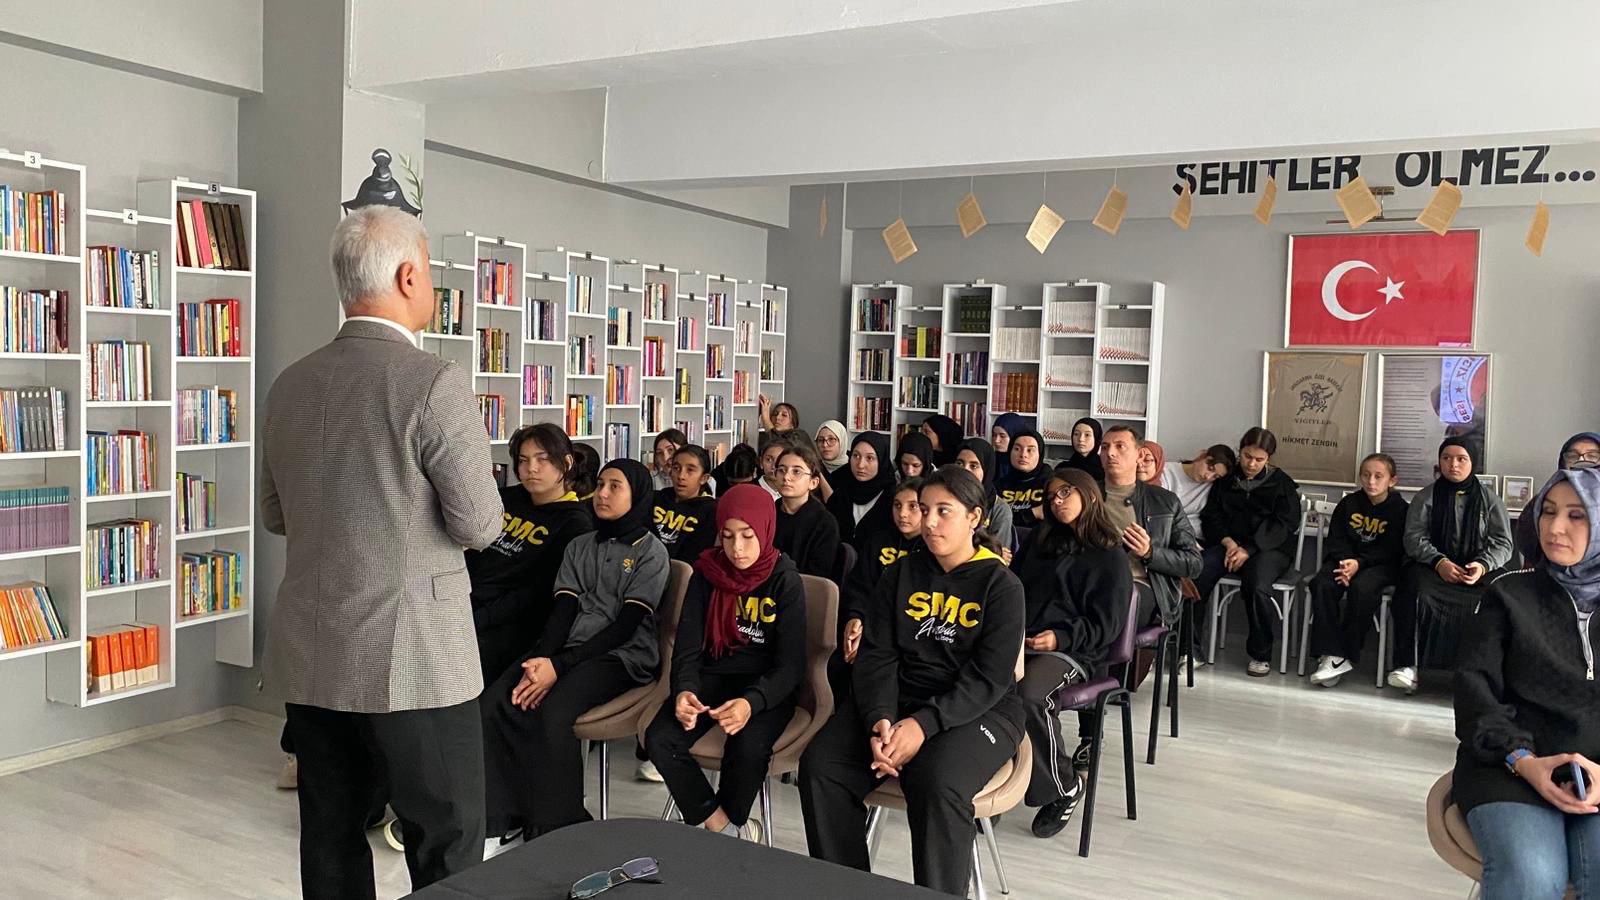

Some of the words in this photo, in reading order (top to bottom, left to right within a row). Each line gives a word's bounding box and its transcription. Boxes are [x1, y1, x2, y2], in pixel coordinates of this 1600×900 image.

[29, 155, 36, 164] 3
[211, 184, 217, 192] 5
[127, 212, 134, 221] 4
[736, 595, 776, 623] MC
[979, 724, 996, 745] VOID
